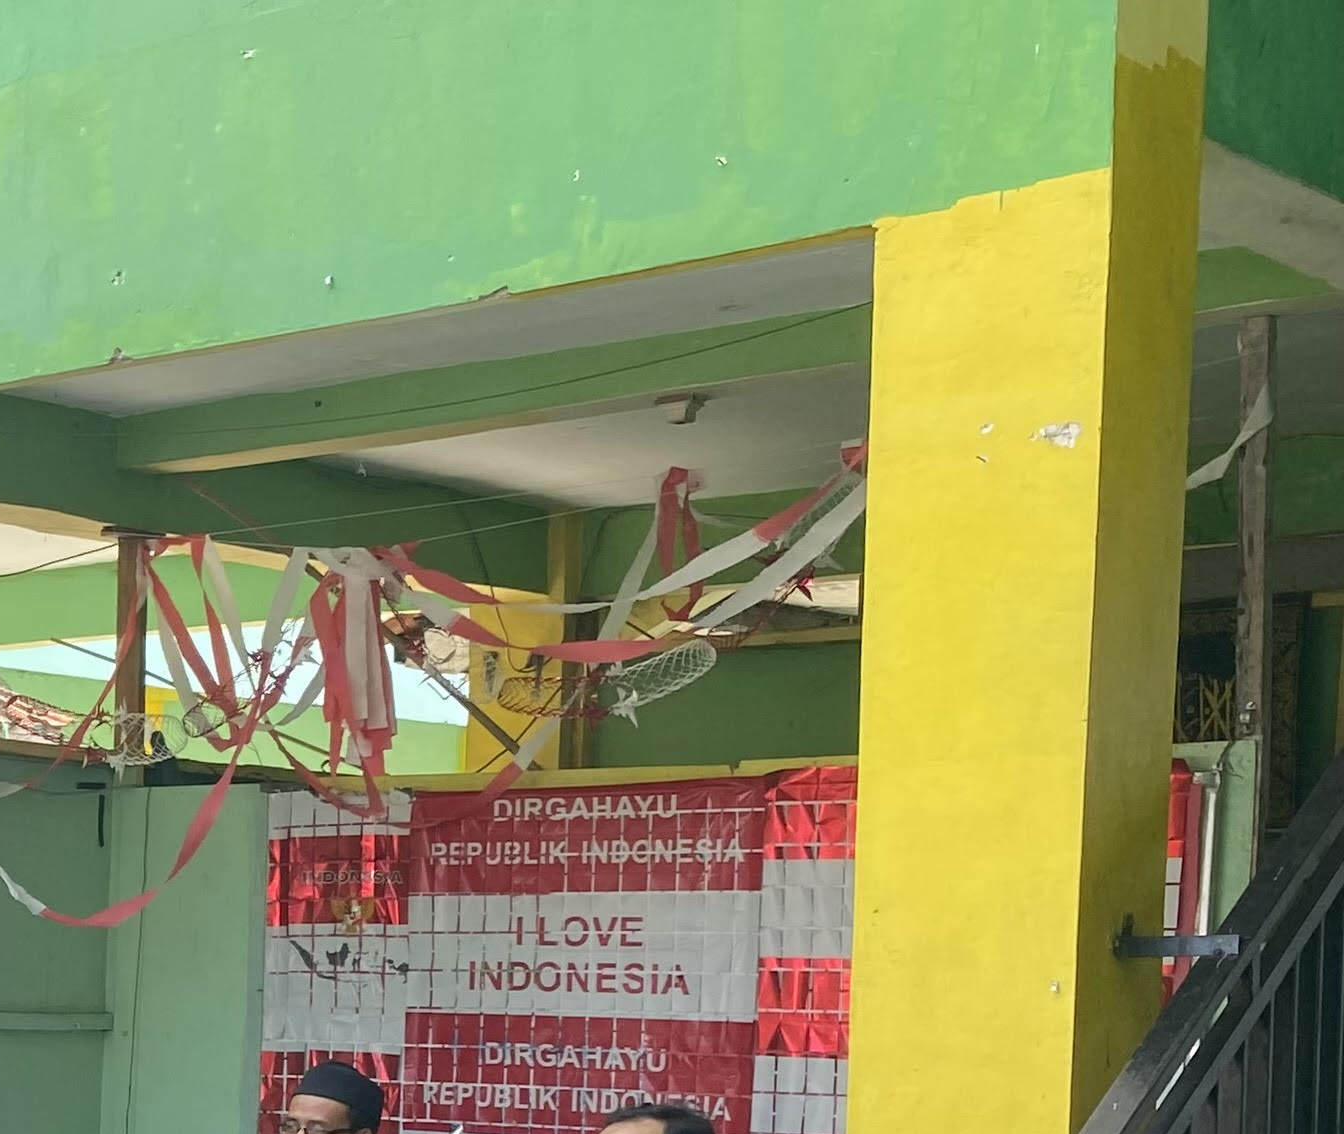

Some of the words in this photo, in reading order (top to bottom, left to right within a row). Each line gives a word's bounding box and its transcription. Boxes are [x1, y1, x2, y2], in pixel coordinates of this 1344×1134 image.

[493, 793, 678, 821] DIRGAHAYU
[429, 842, 567, 866] REPUBLIK
[581, 838, 745, 865] INDONESIA
[515, 915, 524, 946] I
[537, 916, 645, 948] LOVE
[468, 960, 690, 995] INDONESIA
[483, 1042, 668, 1073] DIRGAHAYU
[423, 1082, 559, 1112] REPUBLIK
